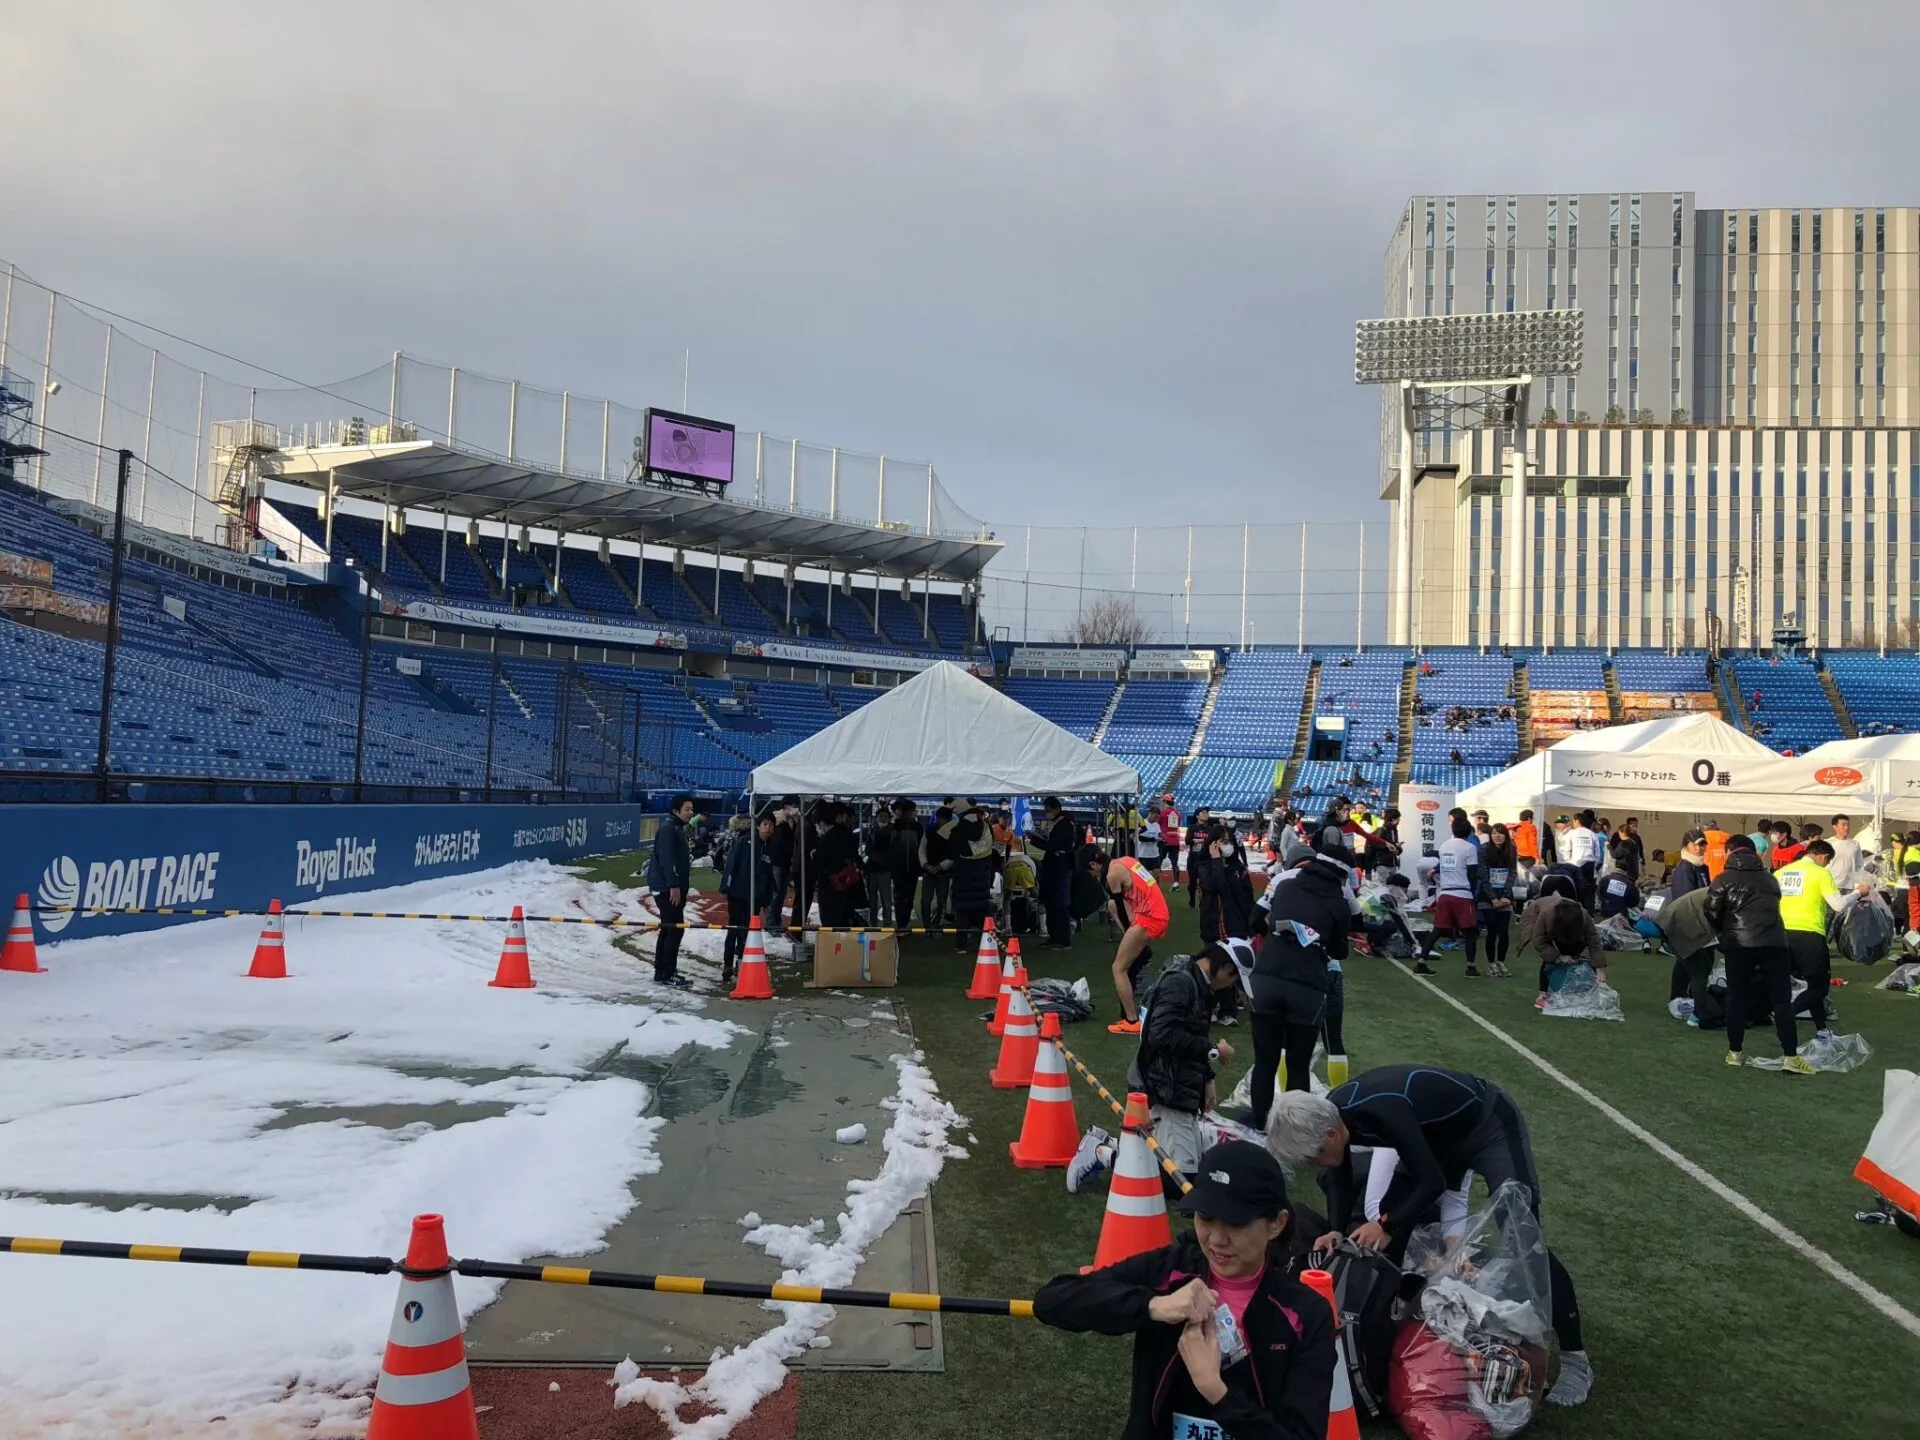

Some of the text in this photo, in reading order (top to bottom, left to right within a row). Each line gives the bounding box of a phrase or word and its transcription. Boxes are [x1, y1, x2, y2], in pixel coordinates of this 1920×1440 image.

[1567, 769, 1678, 782] ナンバーカード下ひとけた
[1826, 769, 1852, 777] ハーフ
[1822, 777, 1855, 785] マラソン
[296, 836, 377, 893] Royal Host
[81, 852, 220, 918] BOAT RACE
